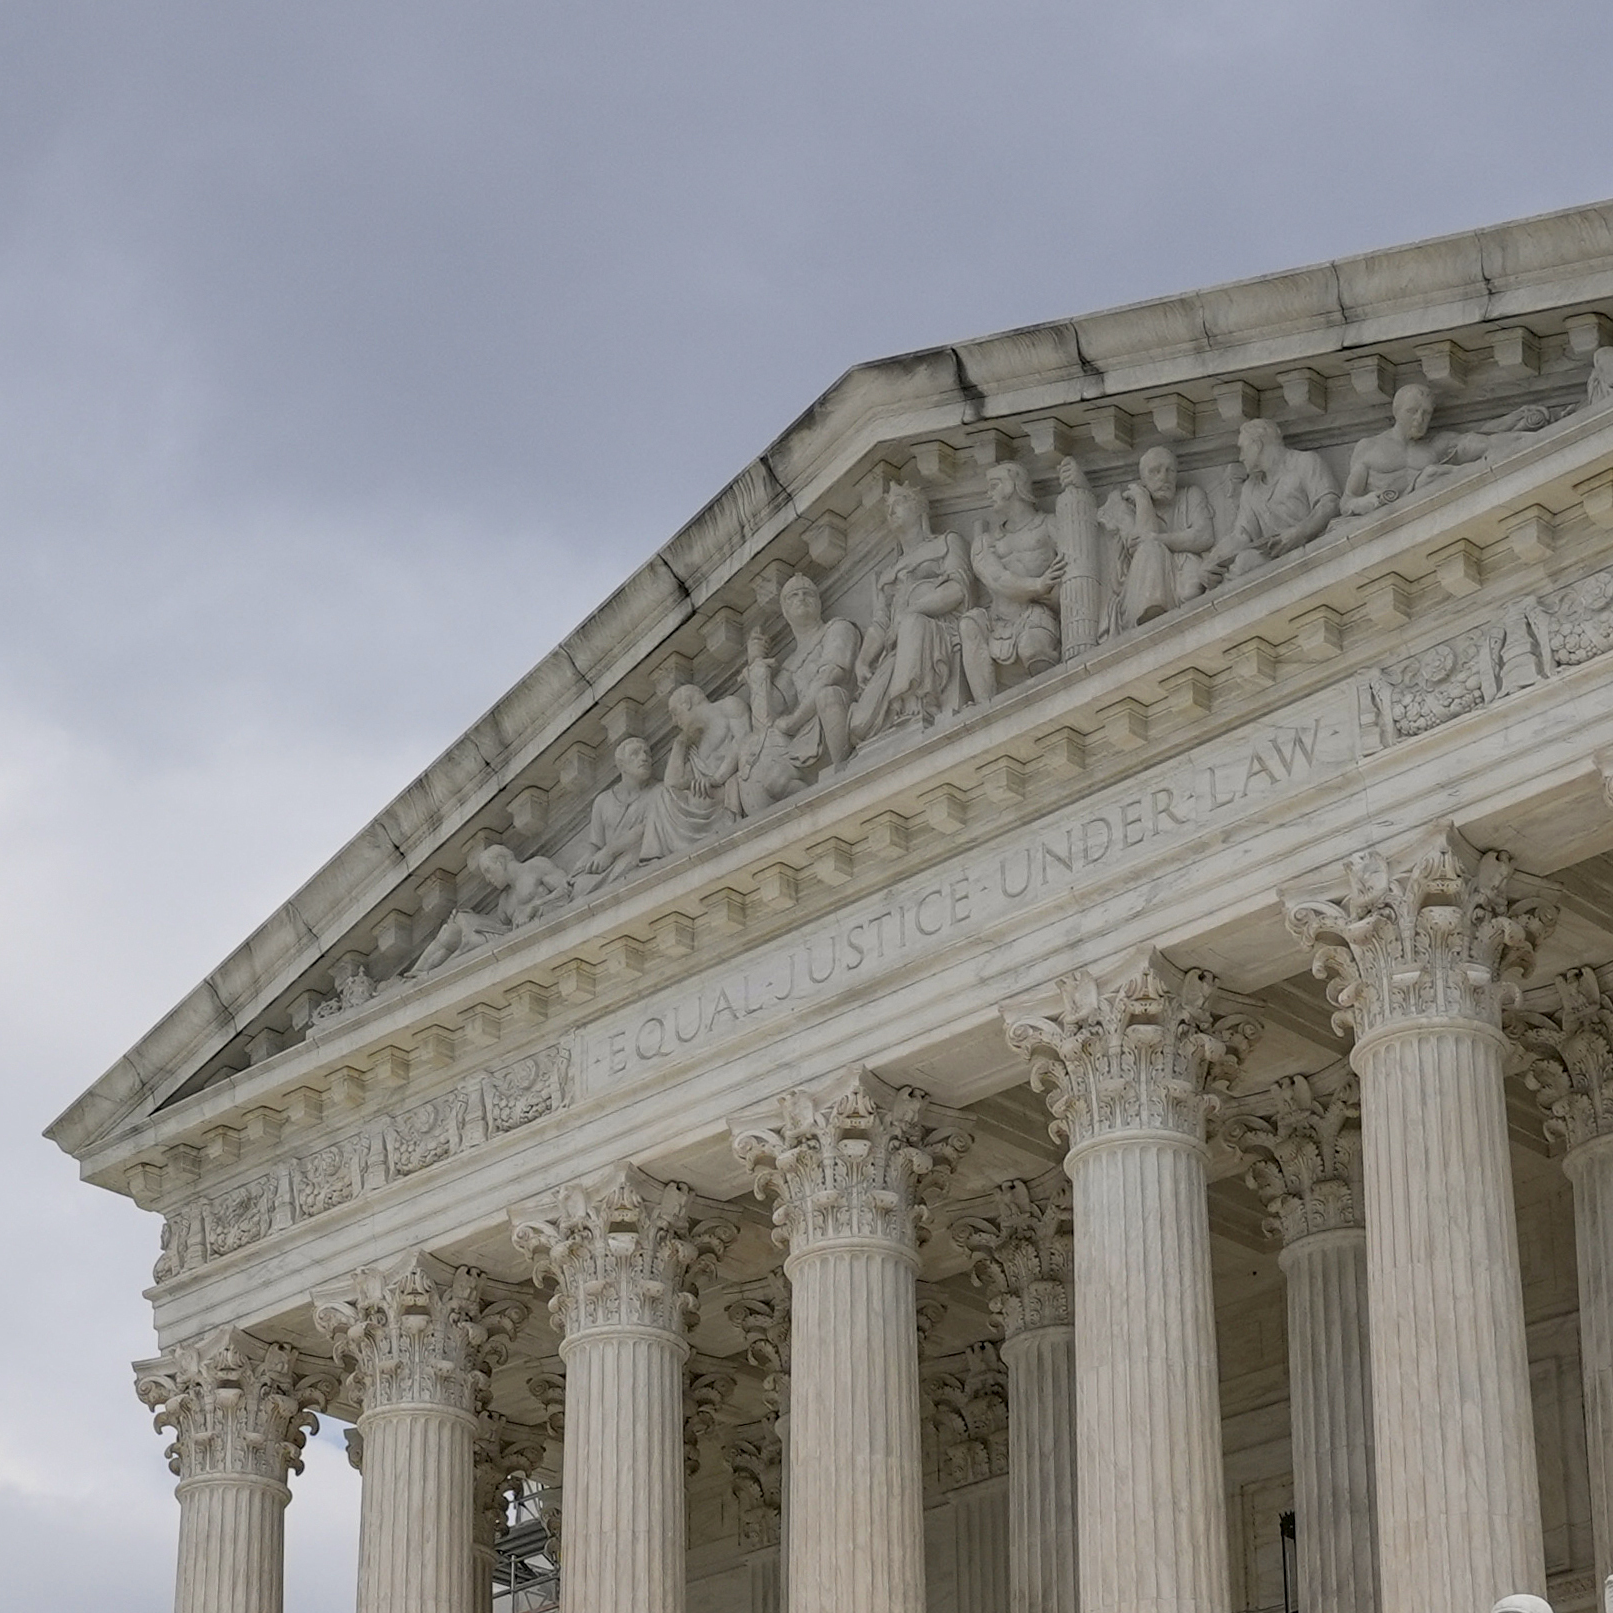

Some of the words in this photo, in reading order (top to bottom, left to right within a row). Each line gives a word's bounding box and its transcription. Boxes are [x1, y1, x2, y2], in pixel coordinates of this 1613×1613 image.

[607, 968, 765, 1076] EQUAL
[774, 877, 972, 1001] JUSTICE
[999, 787, 1190, 899] UNDER
[1206, 715, 1325, 813] LAW
